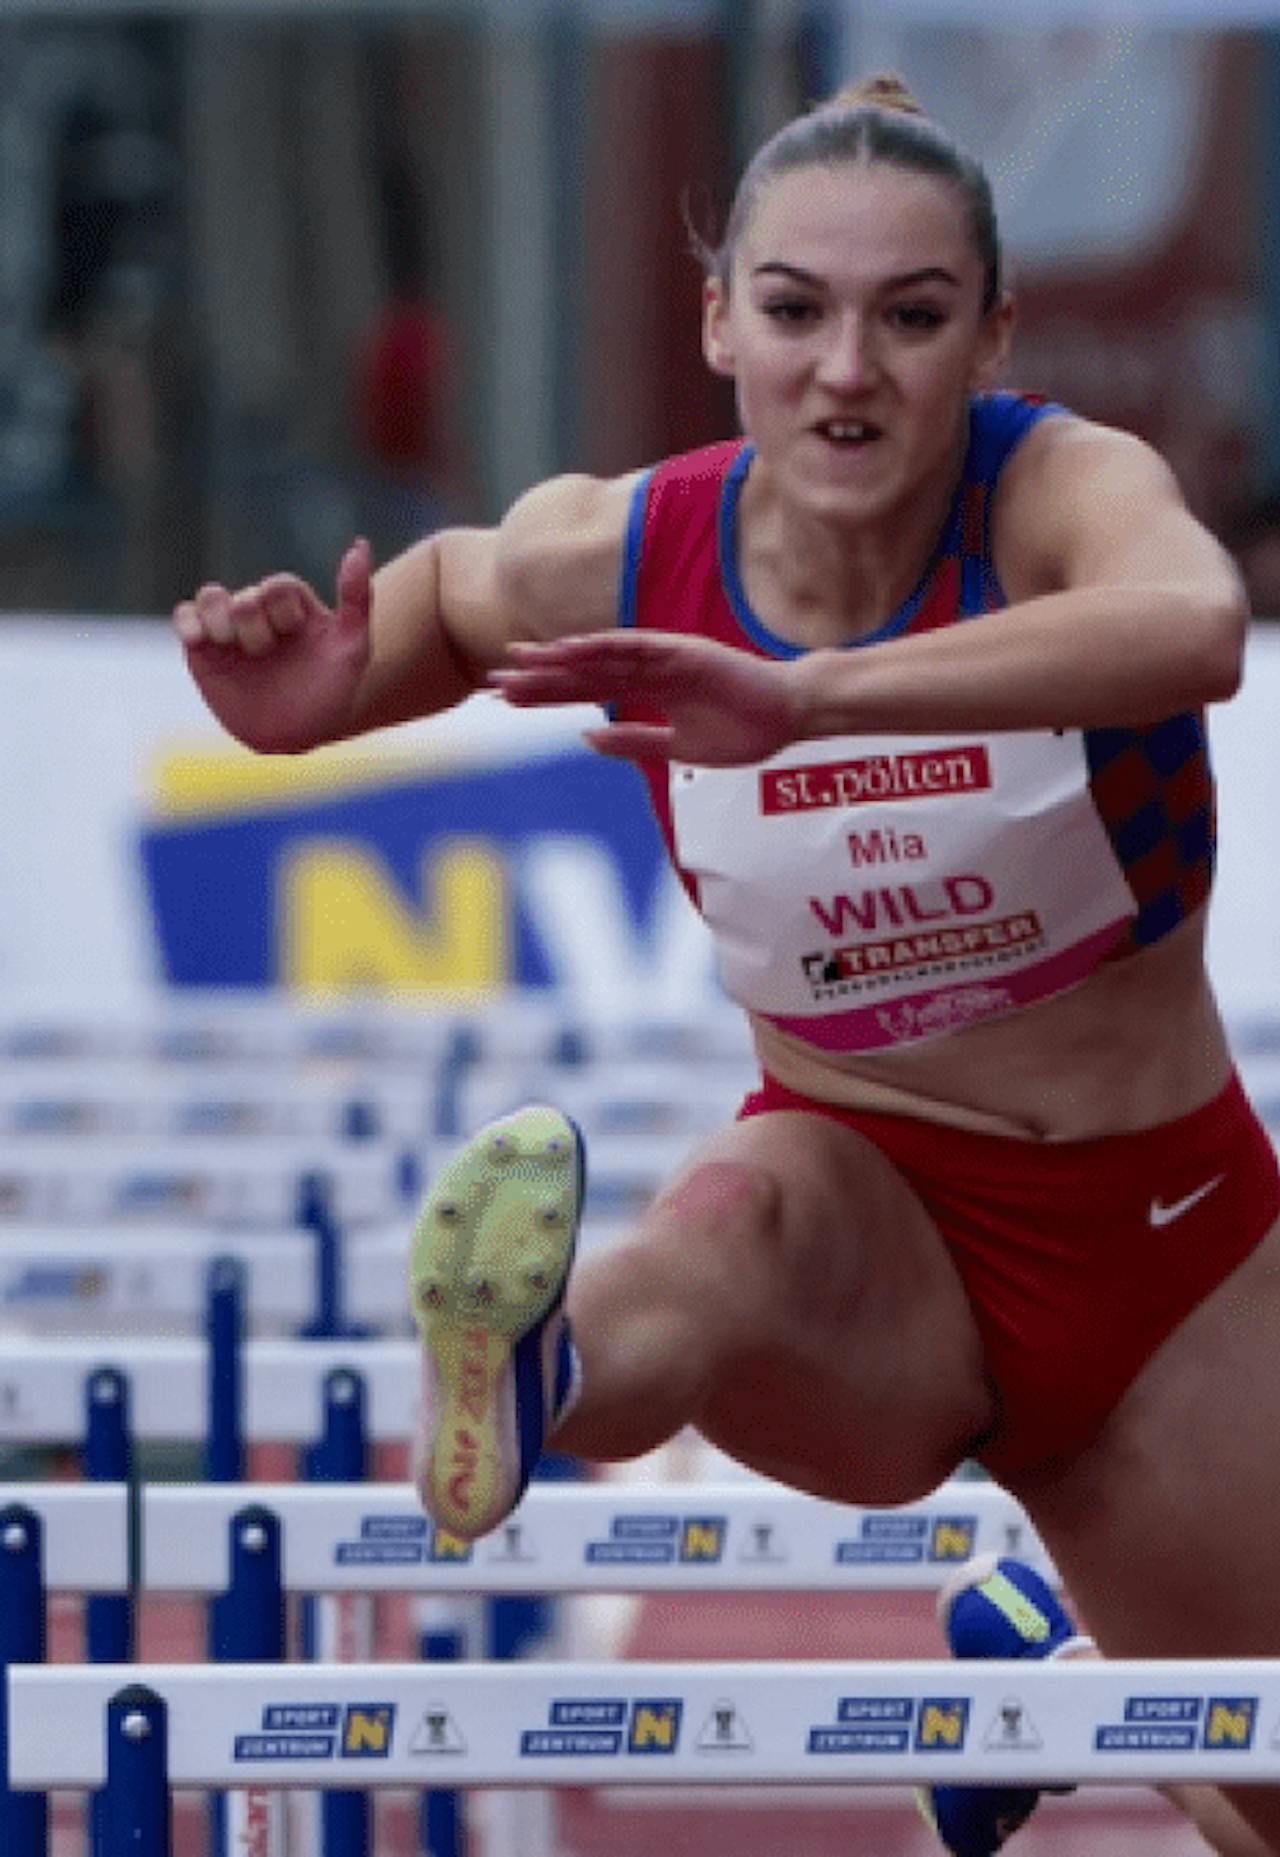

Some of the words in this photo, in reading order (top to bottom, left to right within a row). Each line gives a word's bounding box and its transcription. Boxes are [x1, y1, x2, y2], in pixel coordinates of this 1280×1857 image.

[774, 752, 974, 807] st.pölten
[846, 829, 928, 868] Mia
[808, 874, 996, 937] WILD
[842, 917, 1035, 968] TRANSFER
[345, 1711, 386, 1750] N
[630, 1709, 671, 1748] N
[918, 1705, 959, 1744] N
[1206, 1704, 1247, 1743] N
